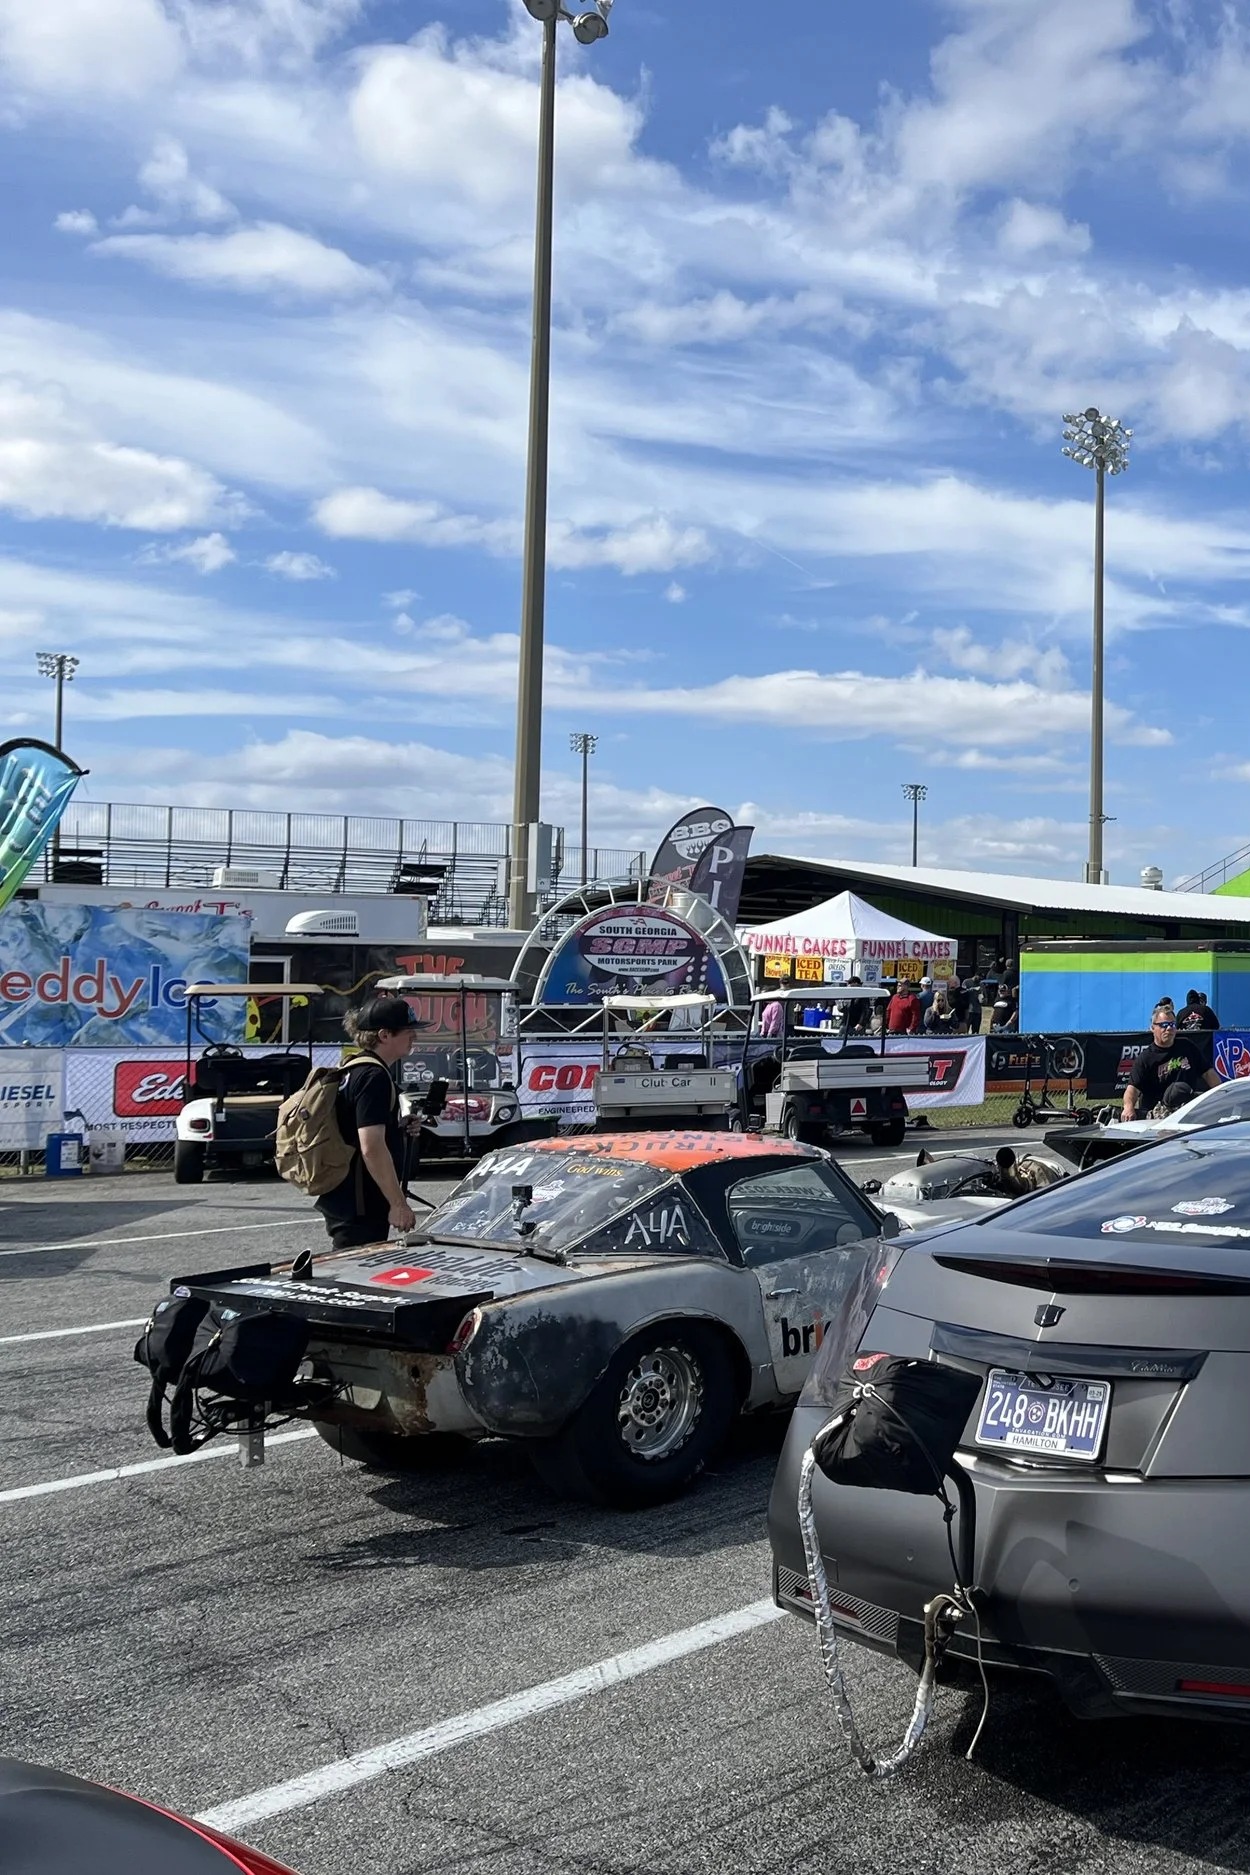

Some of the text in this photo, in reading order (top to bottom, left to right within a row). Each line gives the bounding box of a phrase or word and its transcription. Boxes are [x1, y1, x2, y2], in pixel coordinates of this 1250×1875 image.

[599, 926, 677, 936] SOUTH GEORGIA
[589, 937, 688, 955] SGMP
[748, 933, 847, 957] FUNNEL CAKES
[862, 941, 951, 958] FUNNEL CAKES
[396, 954, 464, 976] THE
[597, 957, 678, 966] MOTORSPORTS PARK
[797, 958, 821, 970] ICED
[899, 963, 918, 973] ICED
[797, 970, 819, 980] TEA
[565, 982, 584, 995] The
[587, 983, 630, 996] South's
[665, 985, 675, 995] to
[671, 1077, 691, 1088] Car
[538, 1106, 594, 1115] ENGINEERED
[467, 1157, 534, 1179] A4A
[567, 1163, 624, 1177] God wins.
[624, 1205, 691, 1246] A4A
[751, 1220, 792, 1234] brightside
[422, 1274, 501, 1292] Racing
[1130, 1360, 1177, 1373] Cadillac
[986, 1391, 1100, 1439] 248 BKHH
[1012, 1436, 1059, 1449] HAMILTON
